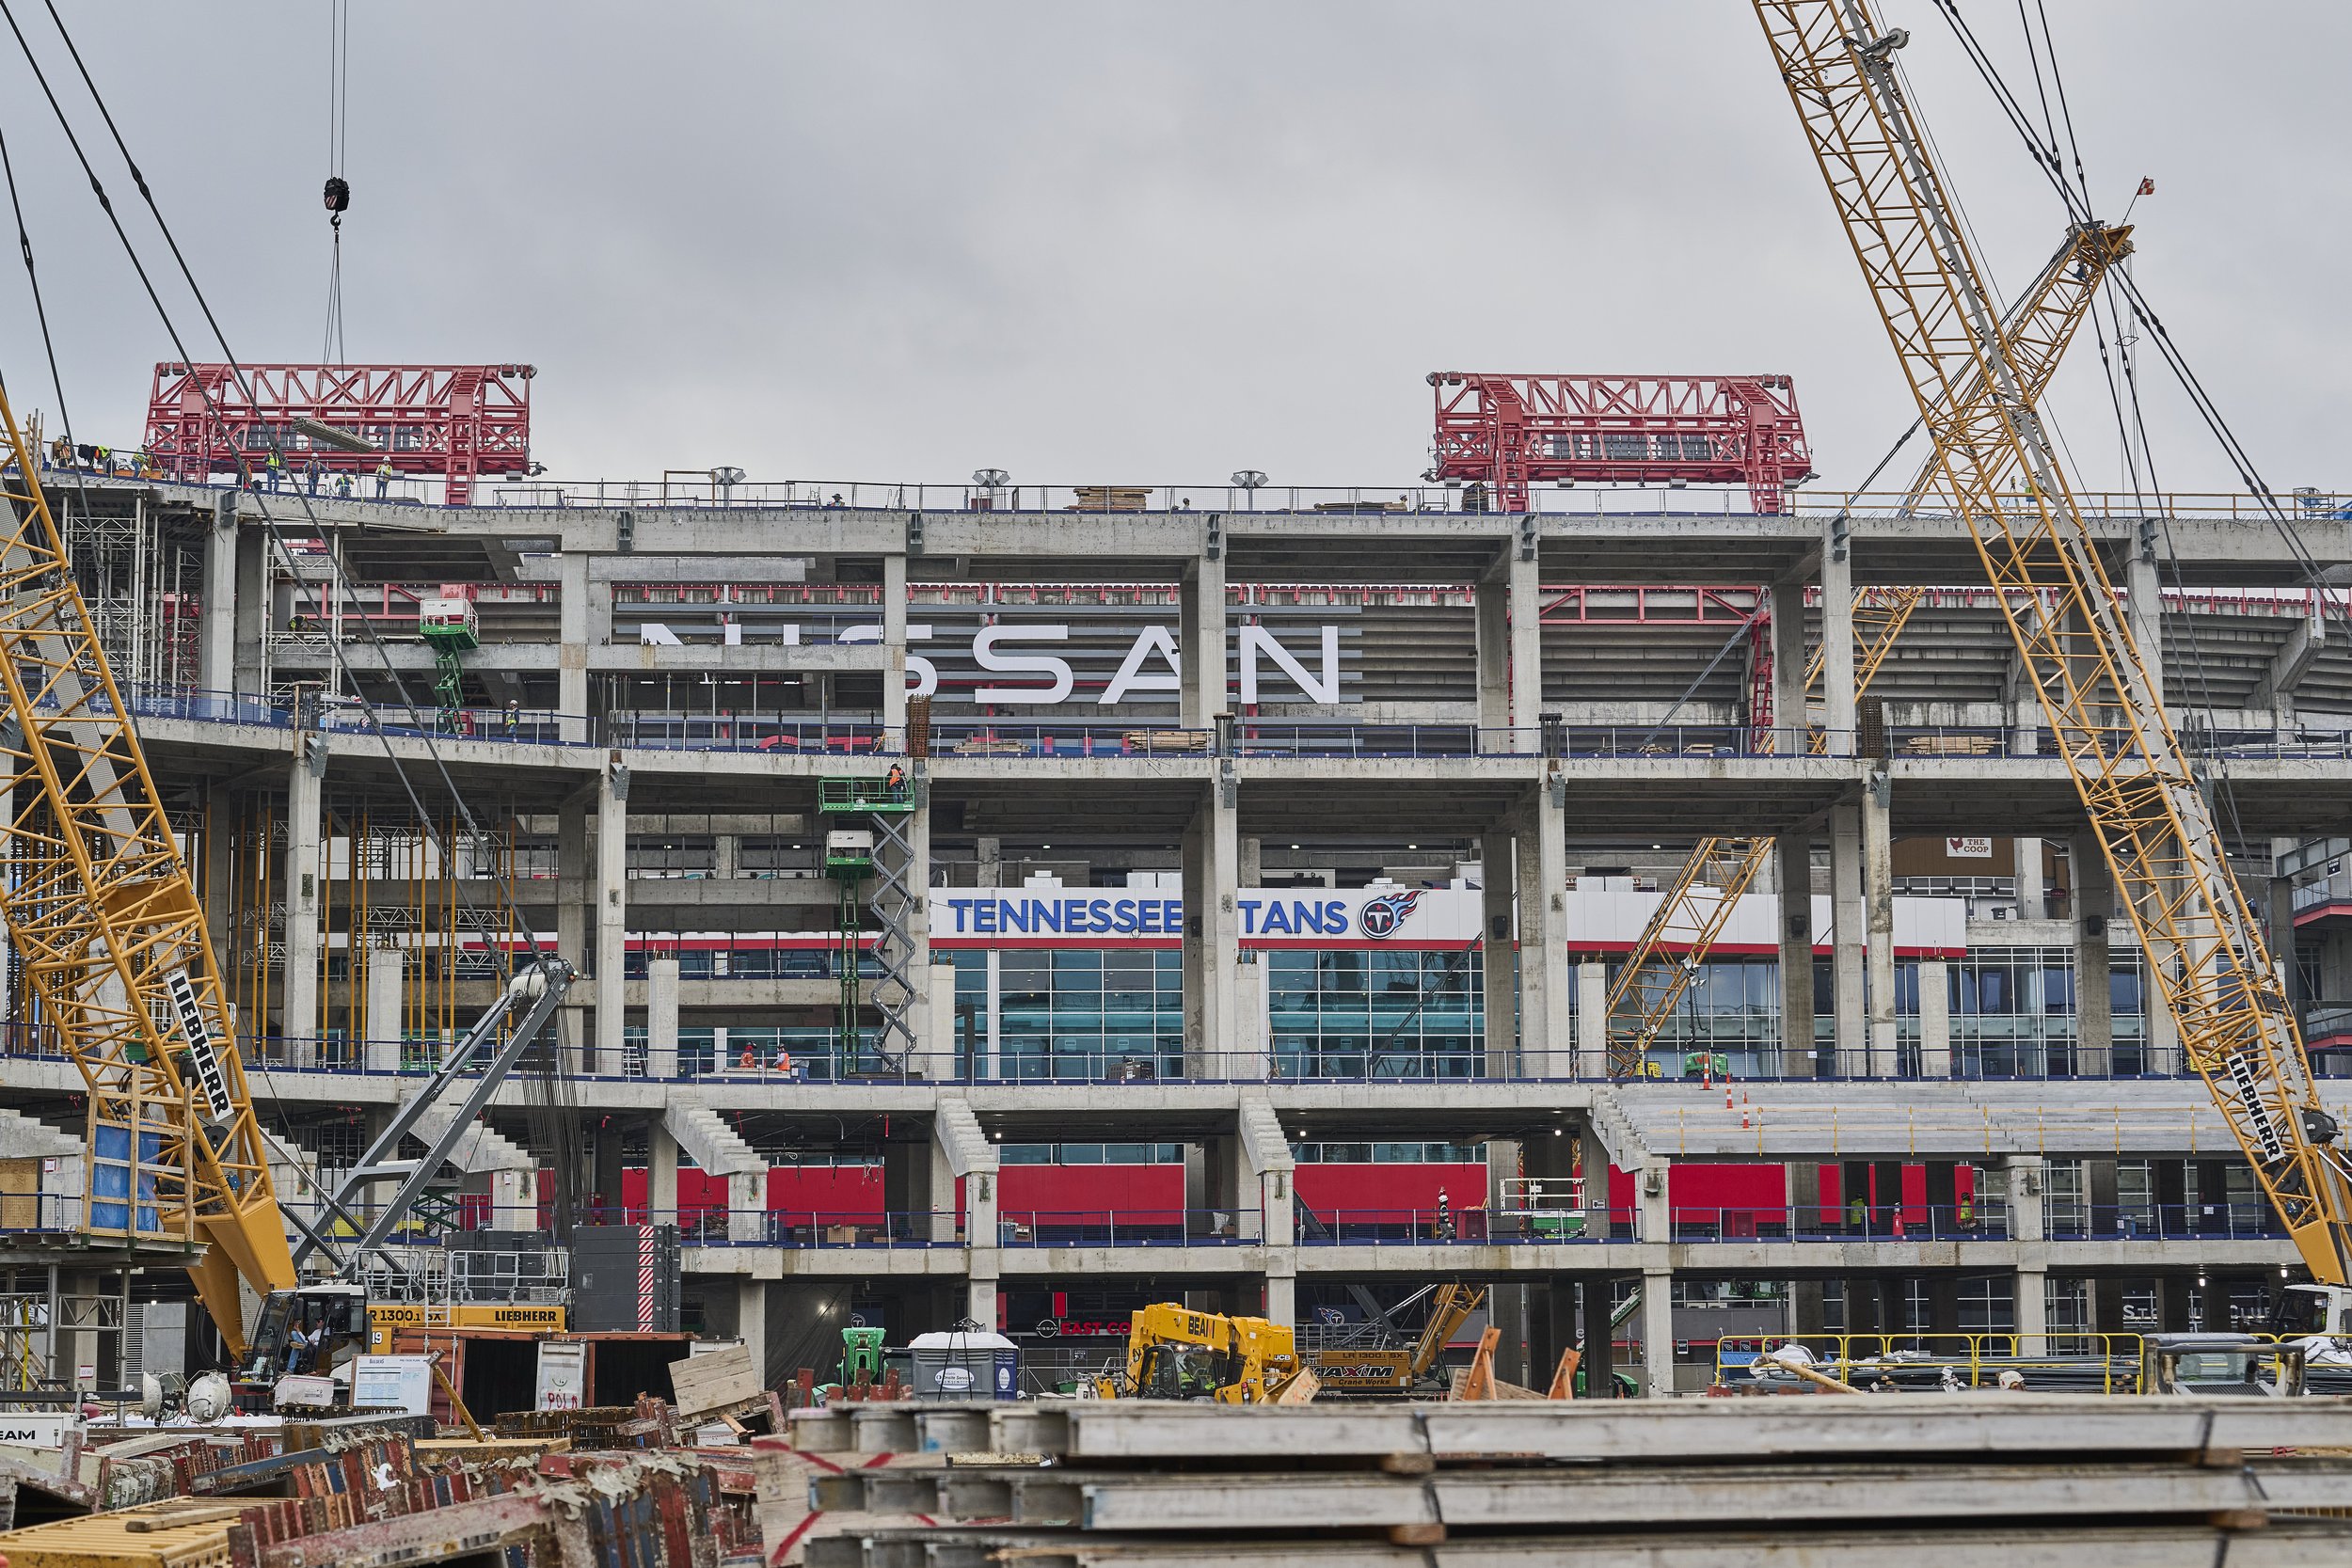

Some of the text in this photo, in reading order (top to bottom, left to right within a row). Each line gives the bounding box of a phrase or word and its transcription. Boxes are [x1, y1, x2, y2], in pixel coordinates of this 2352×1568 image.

[947, 899, 1183, 933] TENNESSEE
[1237, 900, 1349, 934] TANS
[170, 975, 229, 1117] LIEBHERR
[2229, 1056, 2280, 1158] LIEBHERR
[380, 1309, 421, 1322] 1300.1
[495, 1310, 557, 1322] LIEBHERR
[1188, 1315, 1216, 1339] BEAM
[1060, 1322, 1102, 1335] EAST
